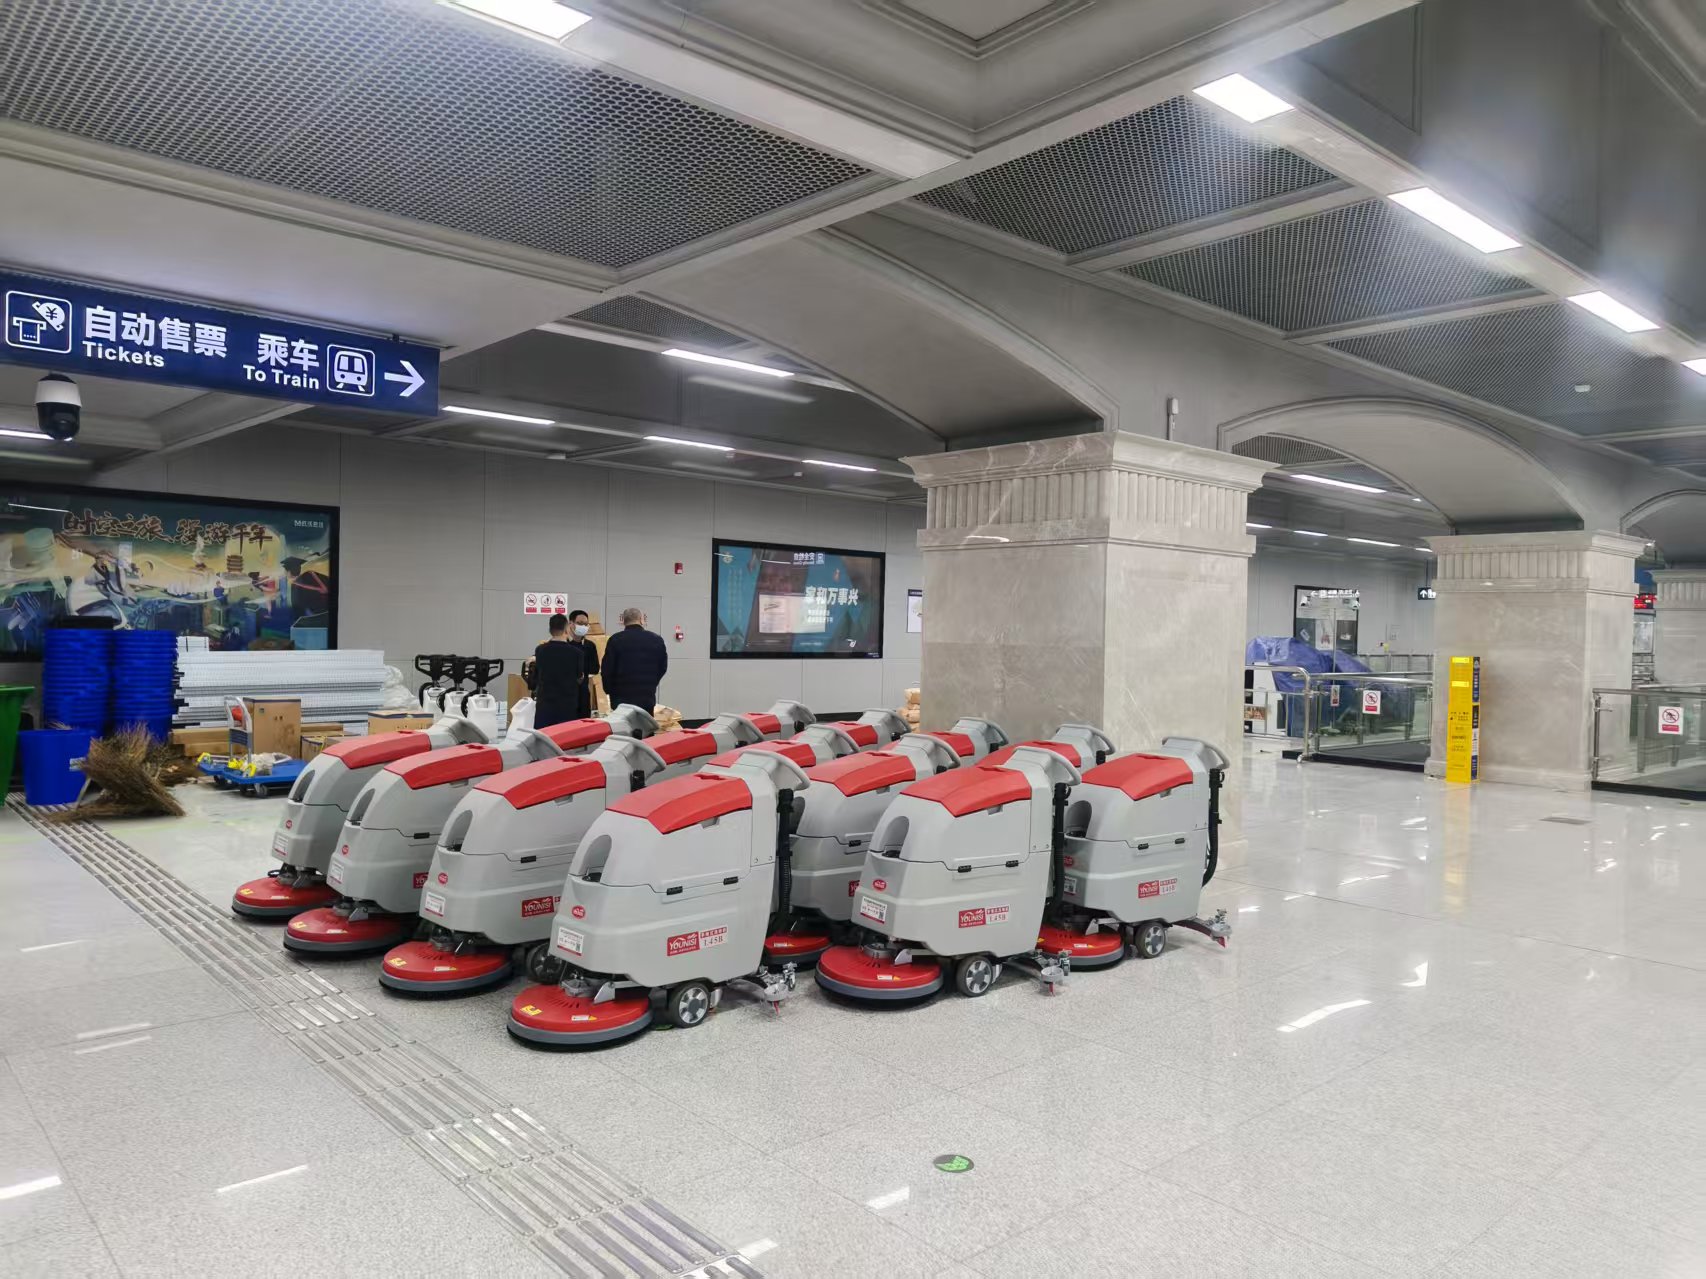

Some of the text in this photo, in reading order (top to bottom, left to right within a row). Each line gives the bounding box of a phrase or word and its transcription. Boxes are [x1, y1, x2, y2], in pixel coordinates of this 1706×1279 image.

[85, 305, 228, 358] 自动售票
[82, 340, 165, 368] Tickets
[257, 333, 320, 371] 乘车
[242, 364, 320, 390] To Train
[805, 585, 859, 606] 家和万事兴
[669, 937, 697, 951] YOUNISI
